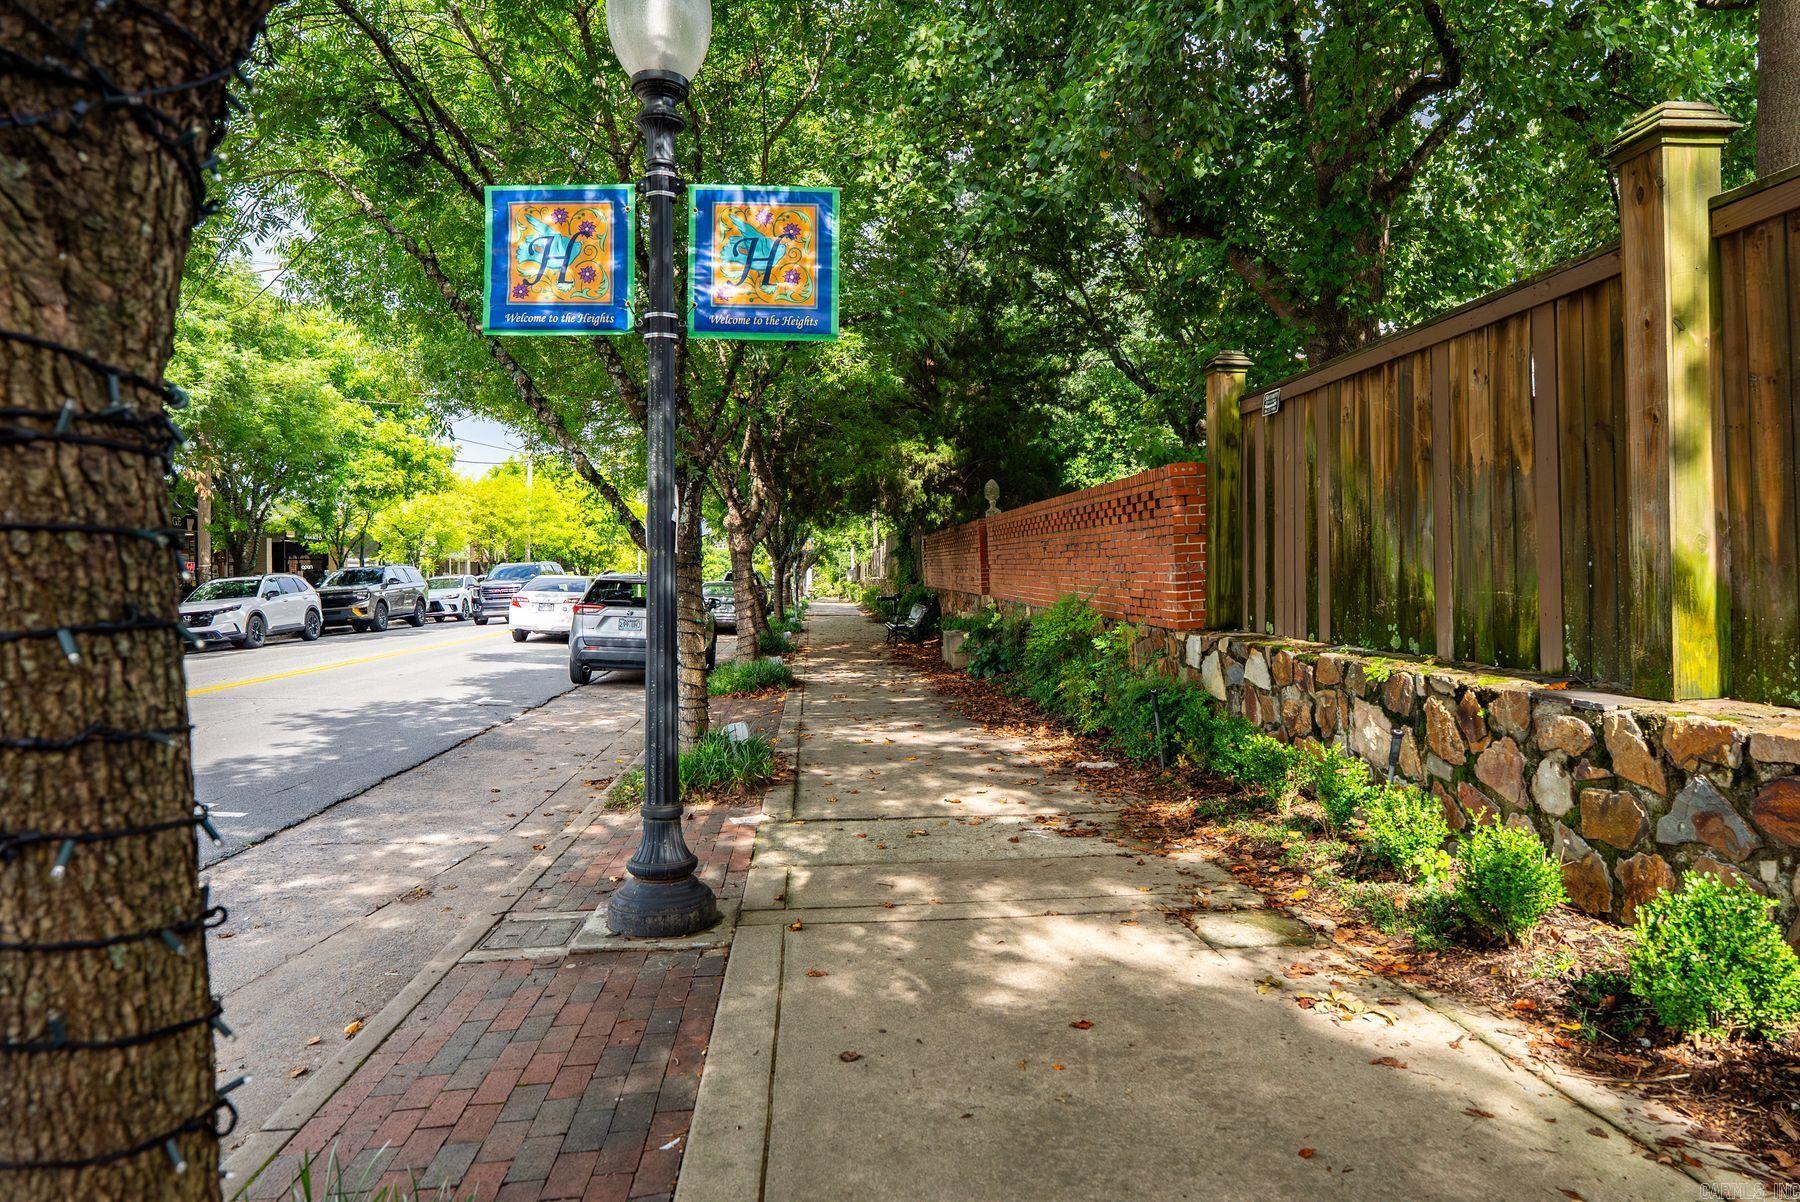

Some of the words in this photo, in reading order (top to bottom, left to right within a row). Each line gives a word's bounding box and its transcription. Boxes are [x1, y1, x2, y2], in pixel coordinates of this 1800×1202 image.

[523, 231, 590, 285] H
[727, 233, 795, 286] H
[505, 312, 546, 323] Welcome
[548, 315, 559, 323] to
[561, 312, 576, 323] the
[576, 312, 615, 326] Heights
[710, 314, 750, 325] Welcome
[753, 316, 763, 325] to
[765, 315, 780, 325] the
[781, 315, 819, 329] Heights
